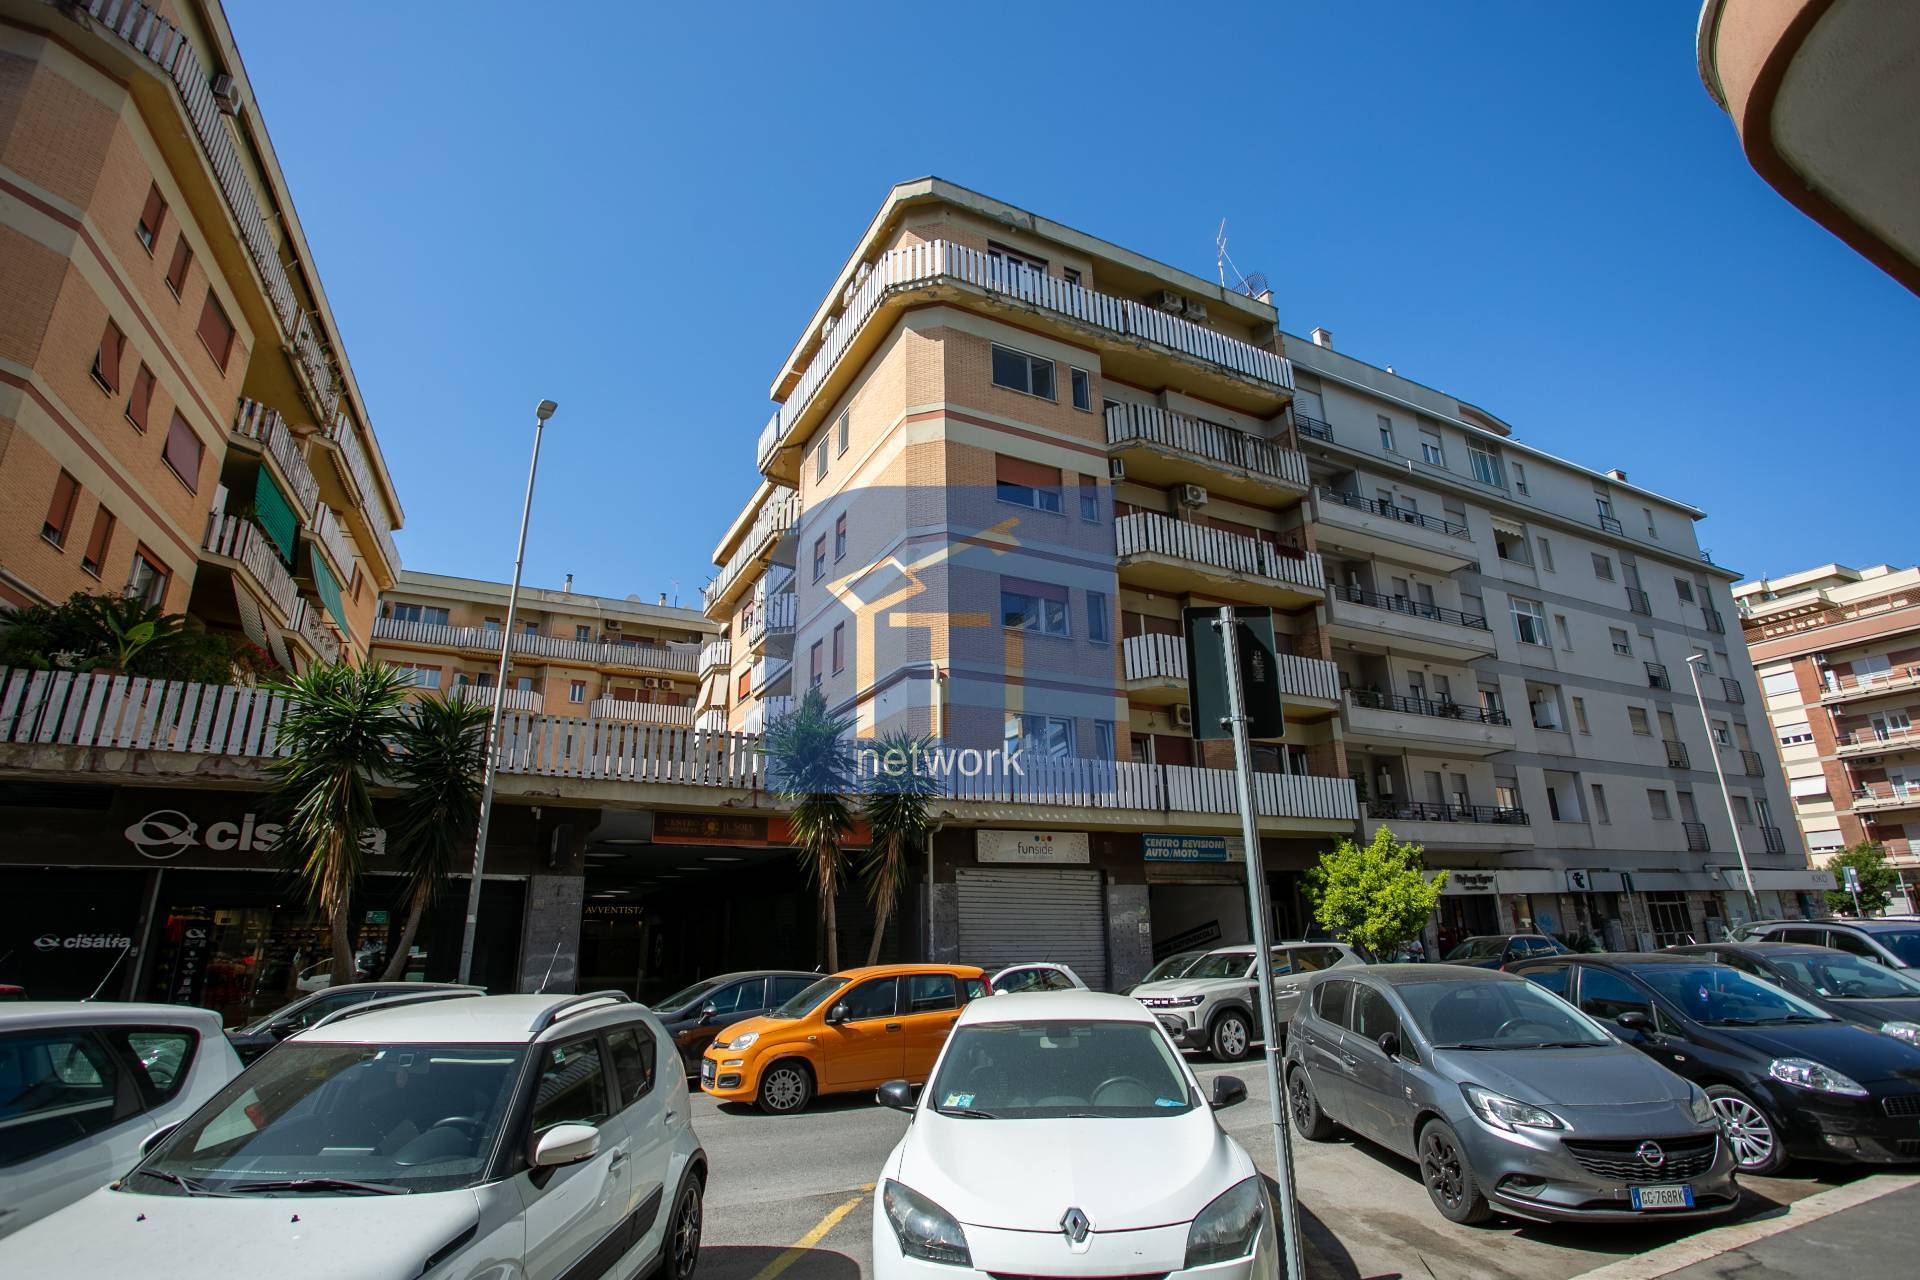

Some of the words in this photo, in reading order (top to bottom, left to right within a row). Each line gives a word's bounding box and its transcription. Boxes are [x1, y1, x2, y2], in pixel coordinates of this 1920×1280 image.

[1017, 841, 1054, 854] funside
[1144, 838, 1180, 848] CENTRO
[1182, 839, 1225, 849] REVISIONI
[1145, 848, 1199, 858] AUTO/MOTO
[63, 936, 131, 948] cisalfa
